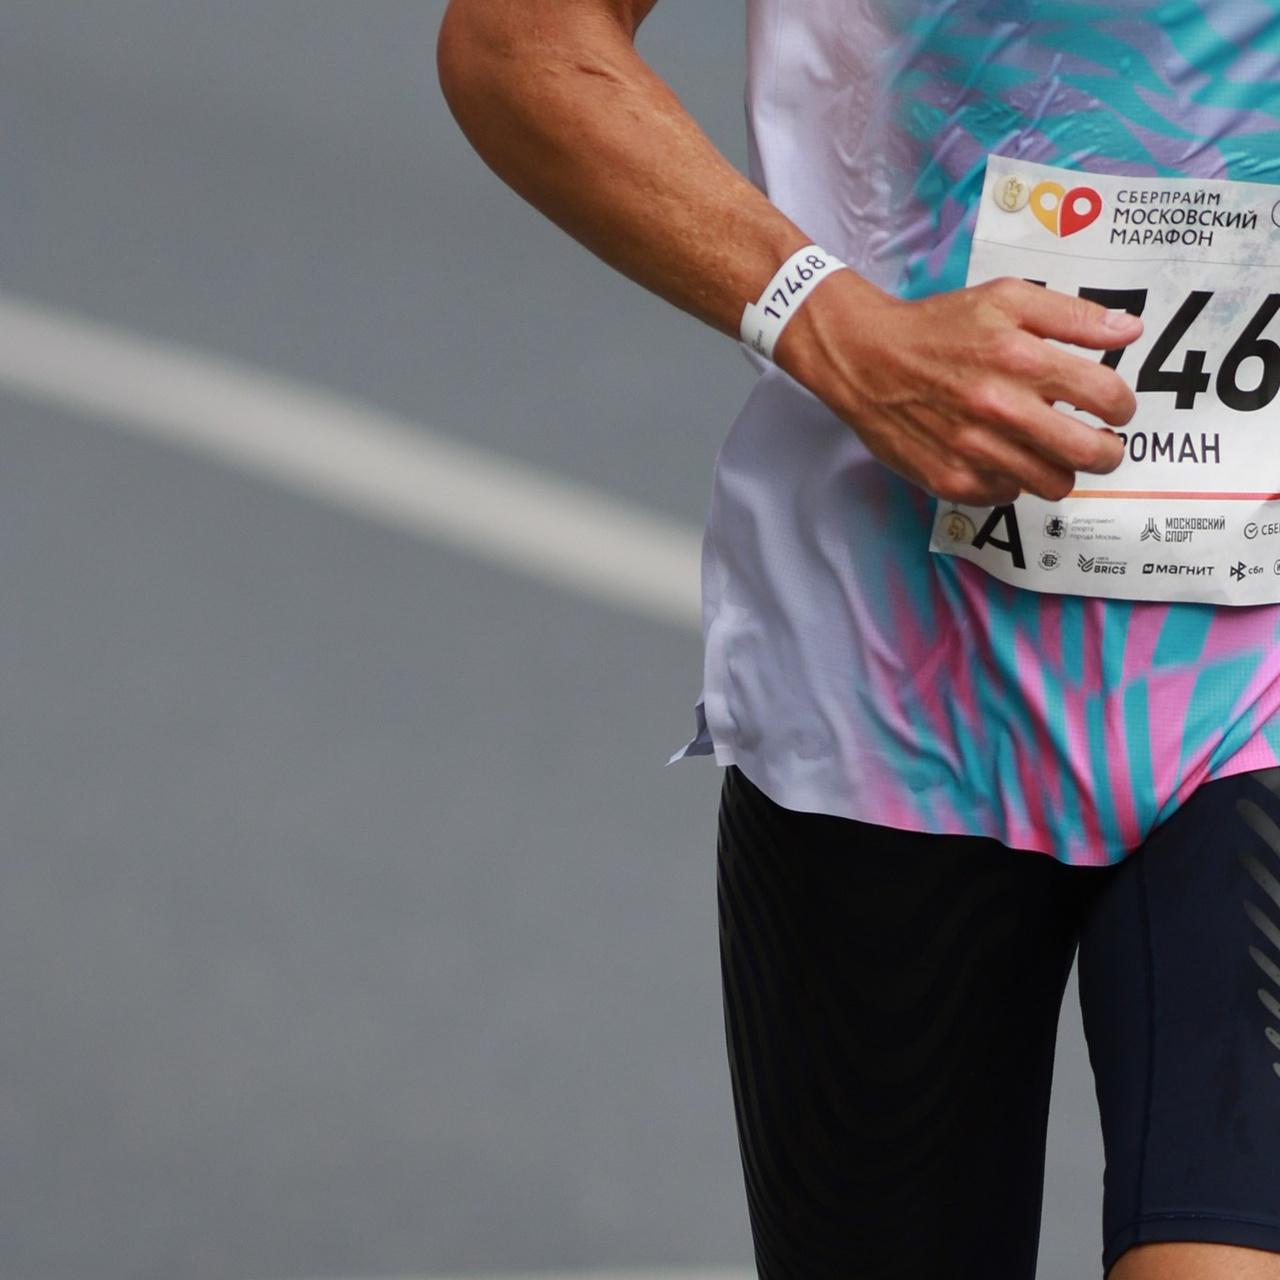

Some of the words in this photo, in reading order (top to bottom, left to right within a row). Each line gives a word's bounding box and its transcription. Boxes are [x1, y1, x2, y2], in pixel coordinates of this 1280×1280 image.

[1116, 189, 1221, 206] СБЕРПРАЙМ
[1113, 208, 1258, 230] МОСКОВСКИЙ
[1110, 227, 1214, 247] МАРАФОН
[764, 254, 826, 320] 17468
[1165, 515, 1226, 531] МОСКОВСКИЙ
[1165, 531, 1193, 543] СПОРТ
[1094, 565, 1127, 575] BRICS
